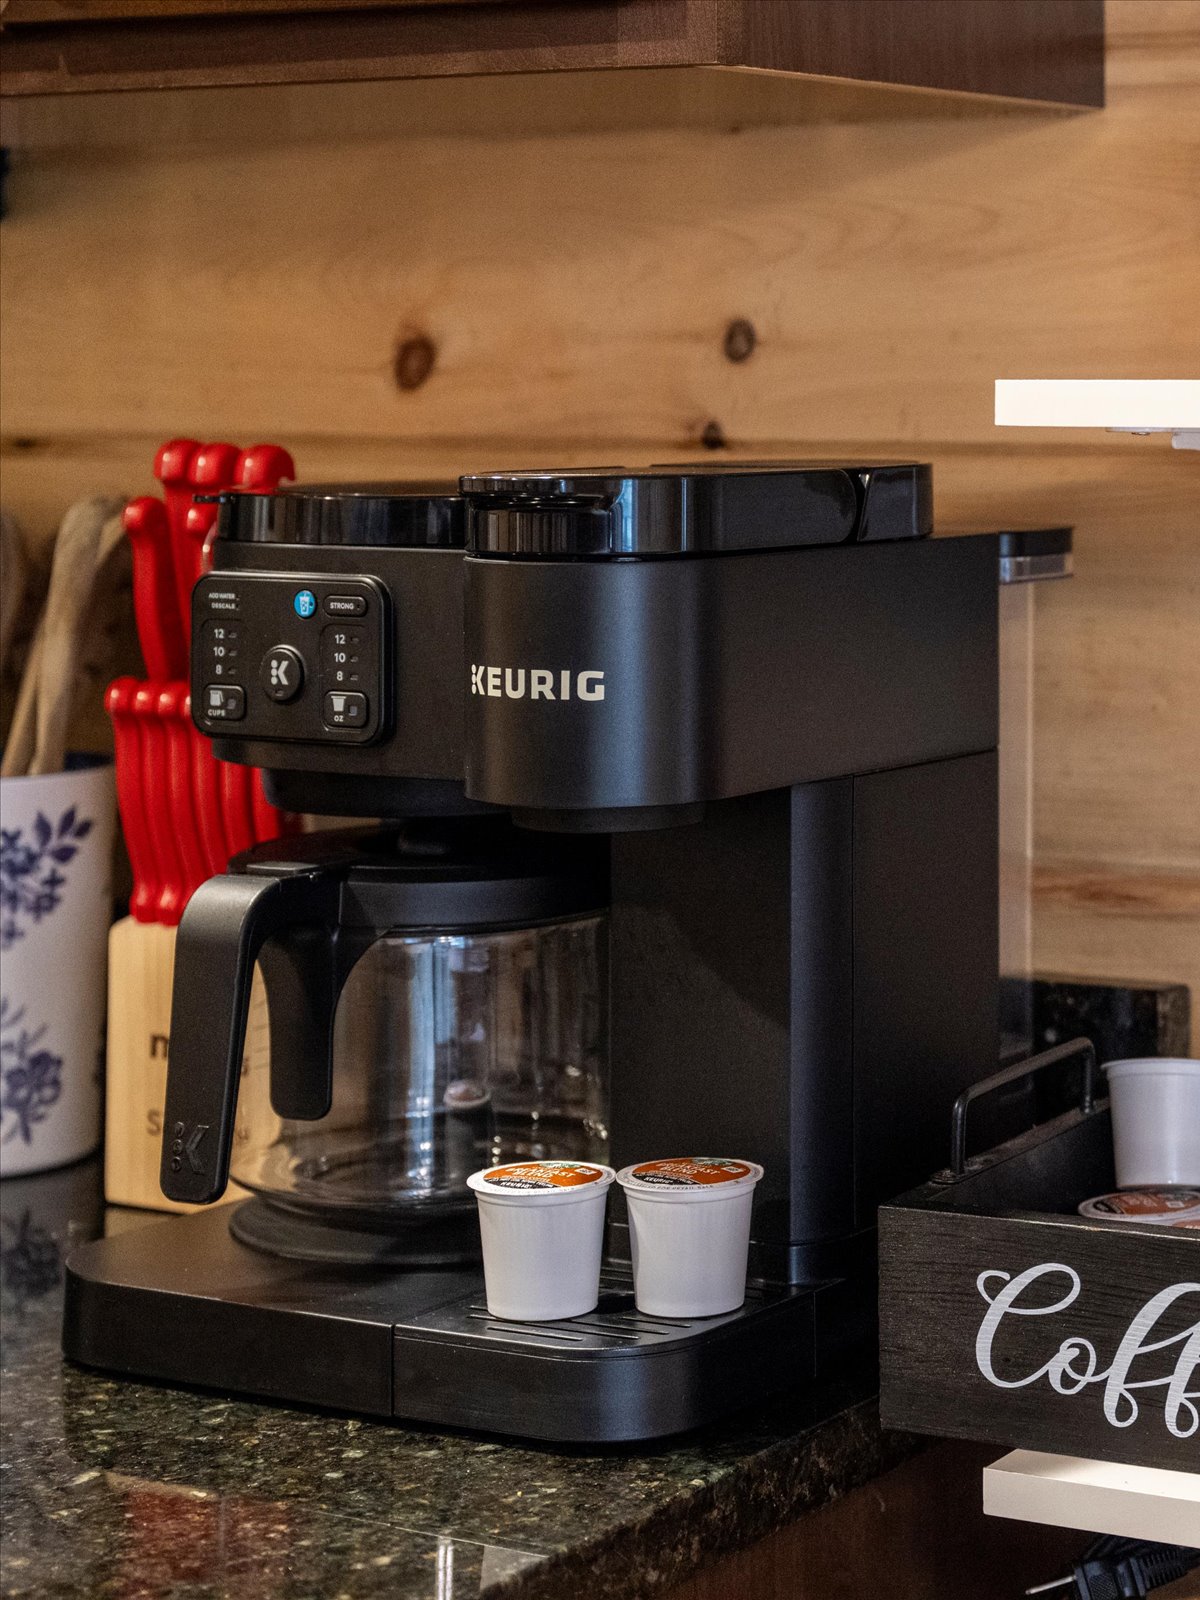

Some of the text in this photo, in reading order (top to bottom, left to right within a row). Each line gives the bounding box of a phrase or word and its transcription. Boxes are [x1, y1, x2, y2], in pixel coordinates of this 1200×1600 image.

[330, 602, 354, 610] STRONG
[214, 628, 225, 639] 12
[335, 634, 346, 645] 12
[213, 647, 225, 657] 10
[334, 653, 346, 663] 10
[215, 664, 222, 675] 8
[336, 671, 343, 681] 8
[471, 664, 605, 701] KEURIG
[208, 709, 226, 717] CUPS
